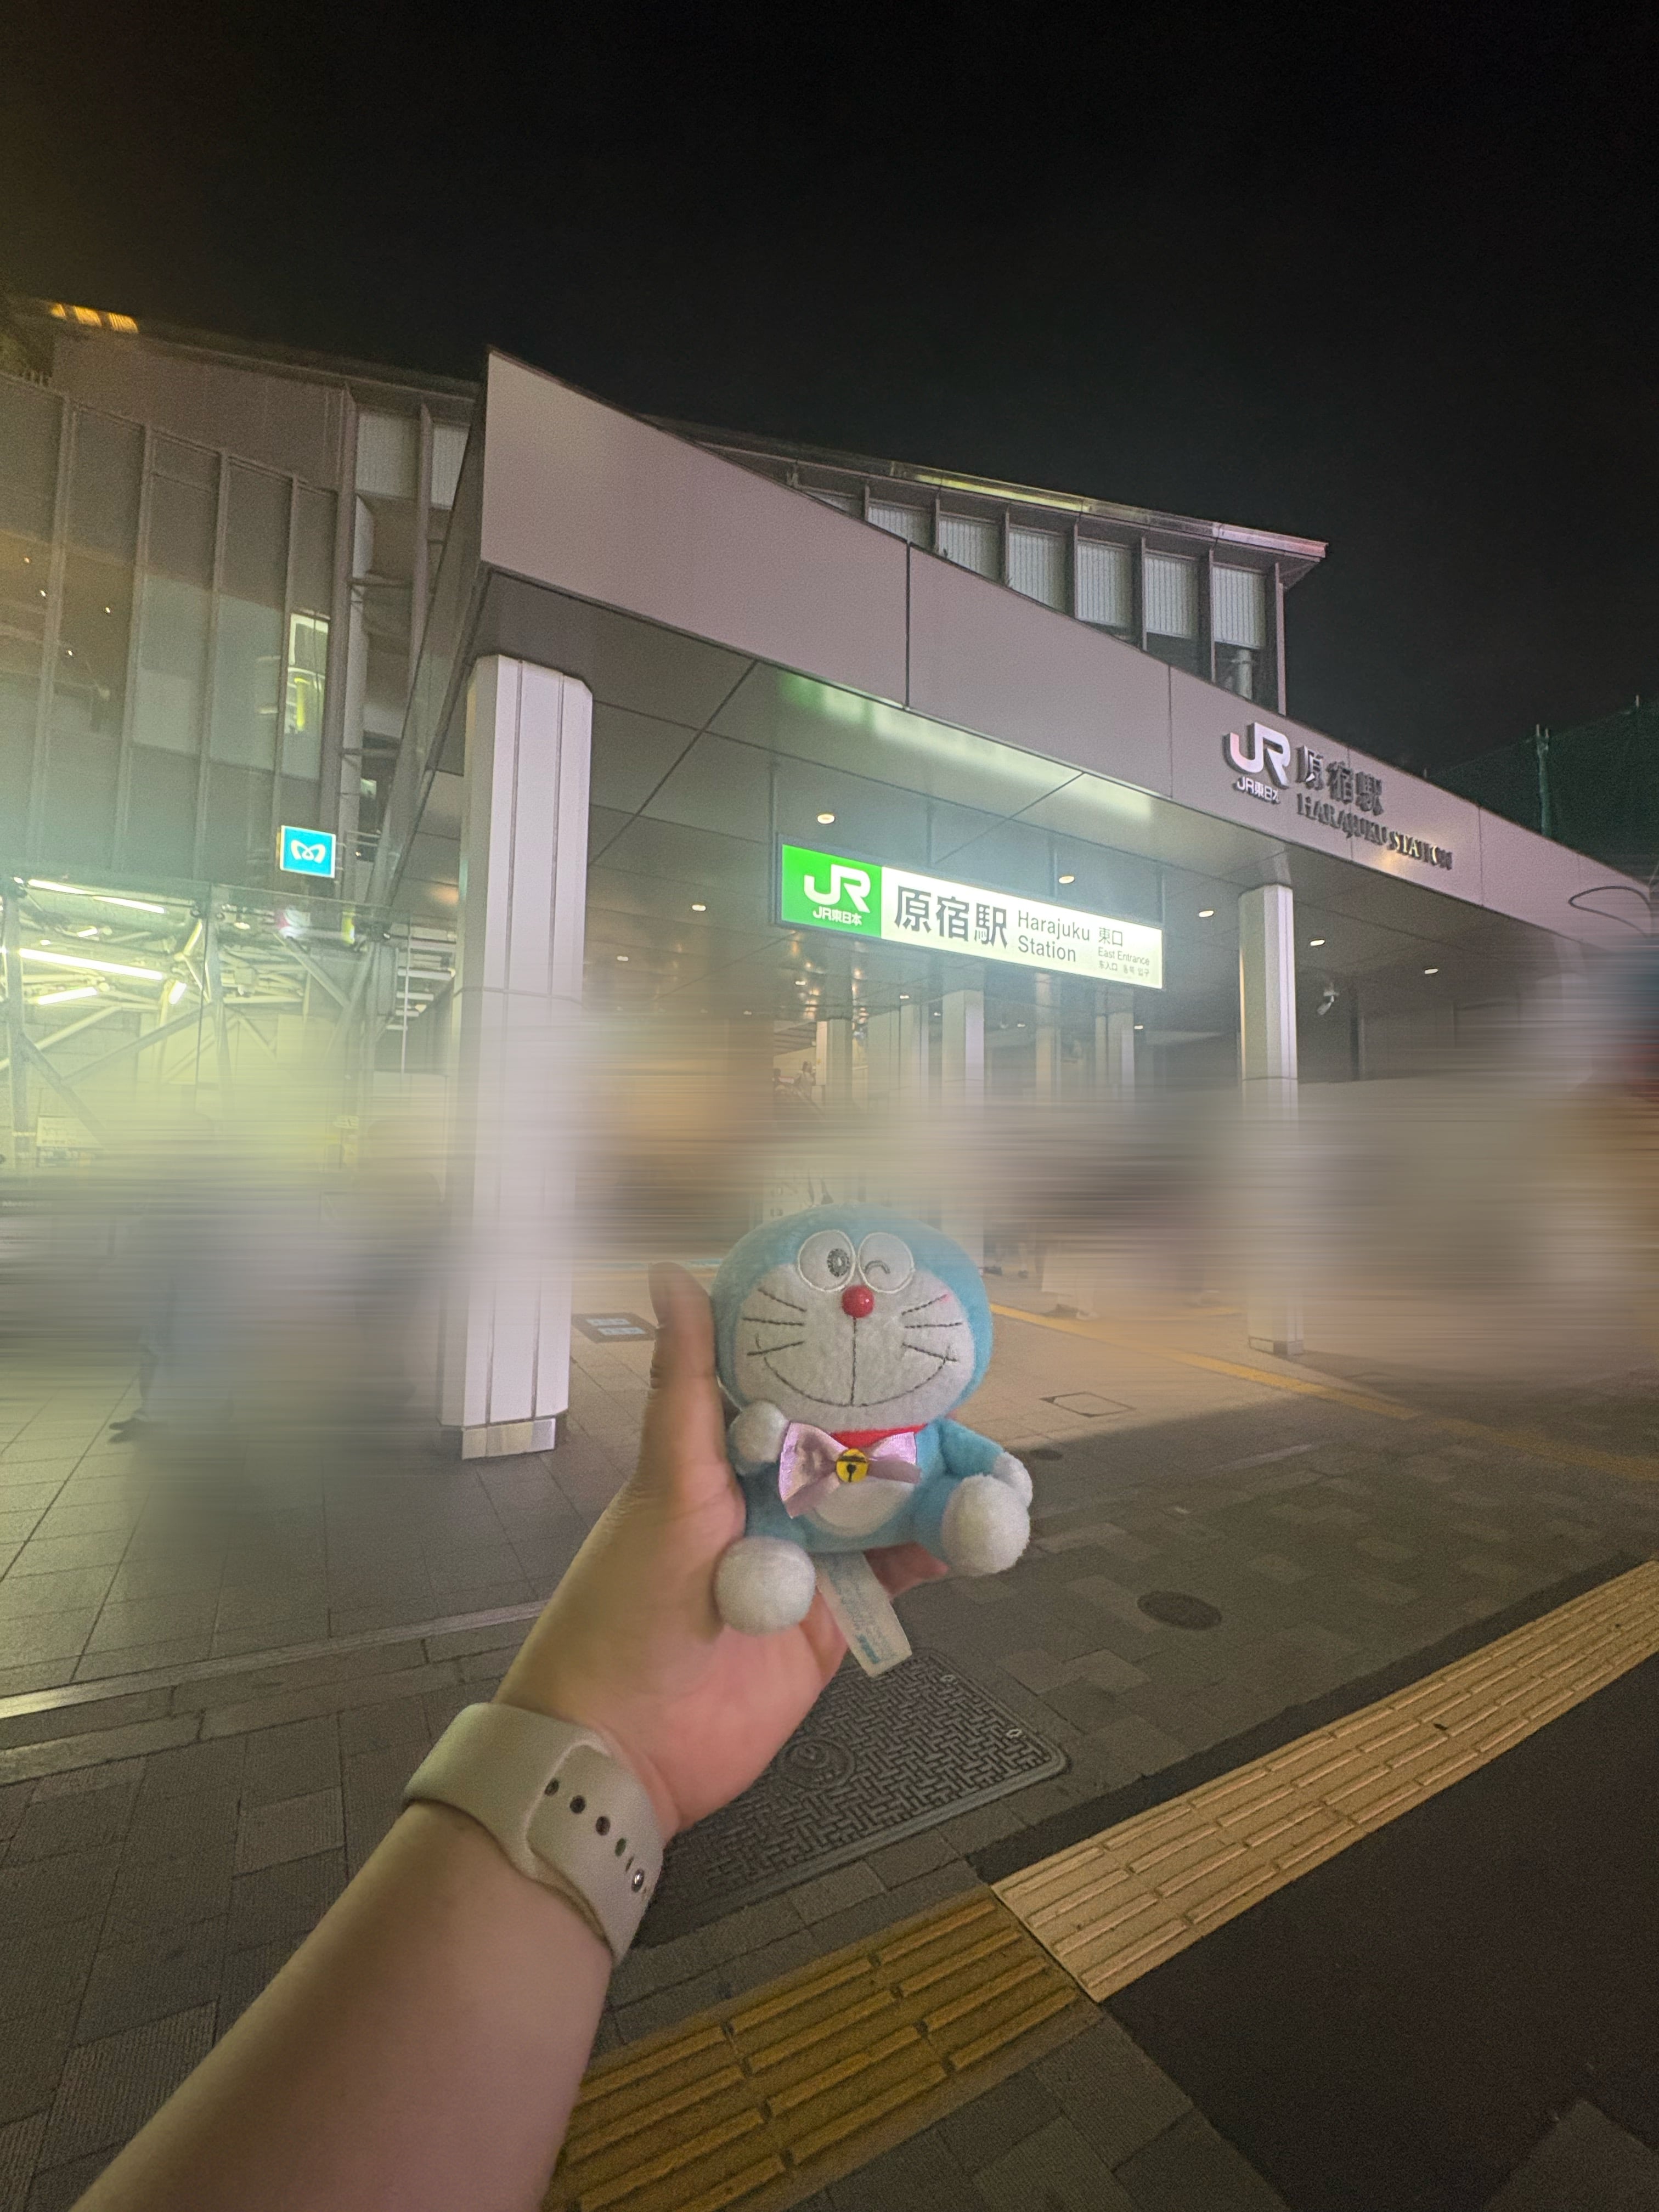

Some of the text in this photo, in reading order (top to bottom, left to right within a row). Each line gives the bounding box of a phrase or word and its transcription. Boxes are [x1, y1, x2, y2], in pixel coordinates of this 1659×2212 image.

[1227, 722, 1291, 789] JR
[804, 864, 871, 913] JR
[812, 906, 862, 926] JR東日本
[894, 885, 1008, 949] 原宿駅
[1018, 910, 1090, 941] Harajuku
[1018, 935, 1076, 962] Station
[1098, 927, 1123, 947] 東口
[1098, 946, 1150, 966] East Entrance
